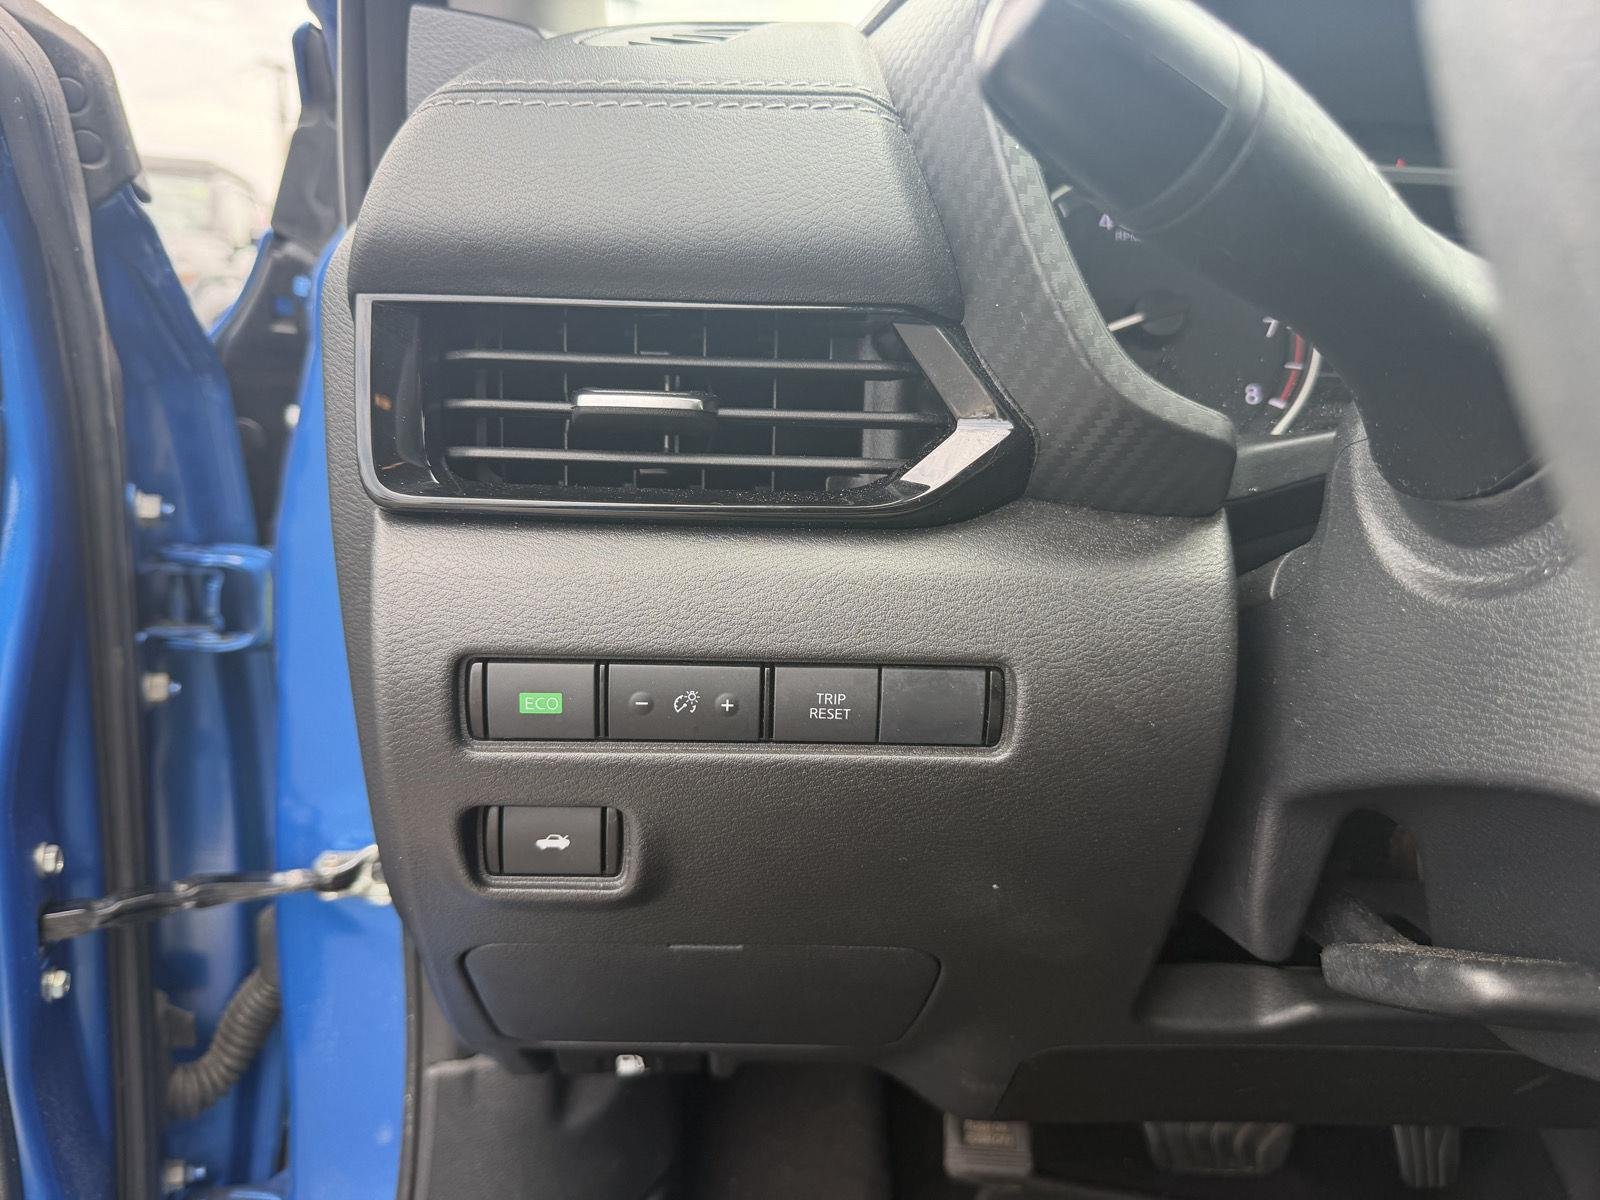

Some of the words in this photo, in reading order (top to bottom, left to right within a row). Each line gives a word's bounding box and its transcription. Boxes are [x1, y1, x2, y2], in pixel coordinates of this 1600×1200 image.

[1099, 214, 1112, 230] 4
[1262, 317, 1278, 337] 7
[1245, 383, 1262, 405] 8
[525, 697, 559, 710] ECO
[816, 693, 846, 705] TRIP
[809, 707, 851, 720] RESET
